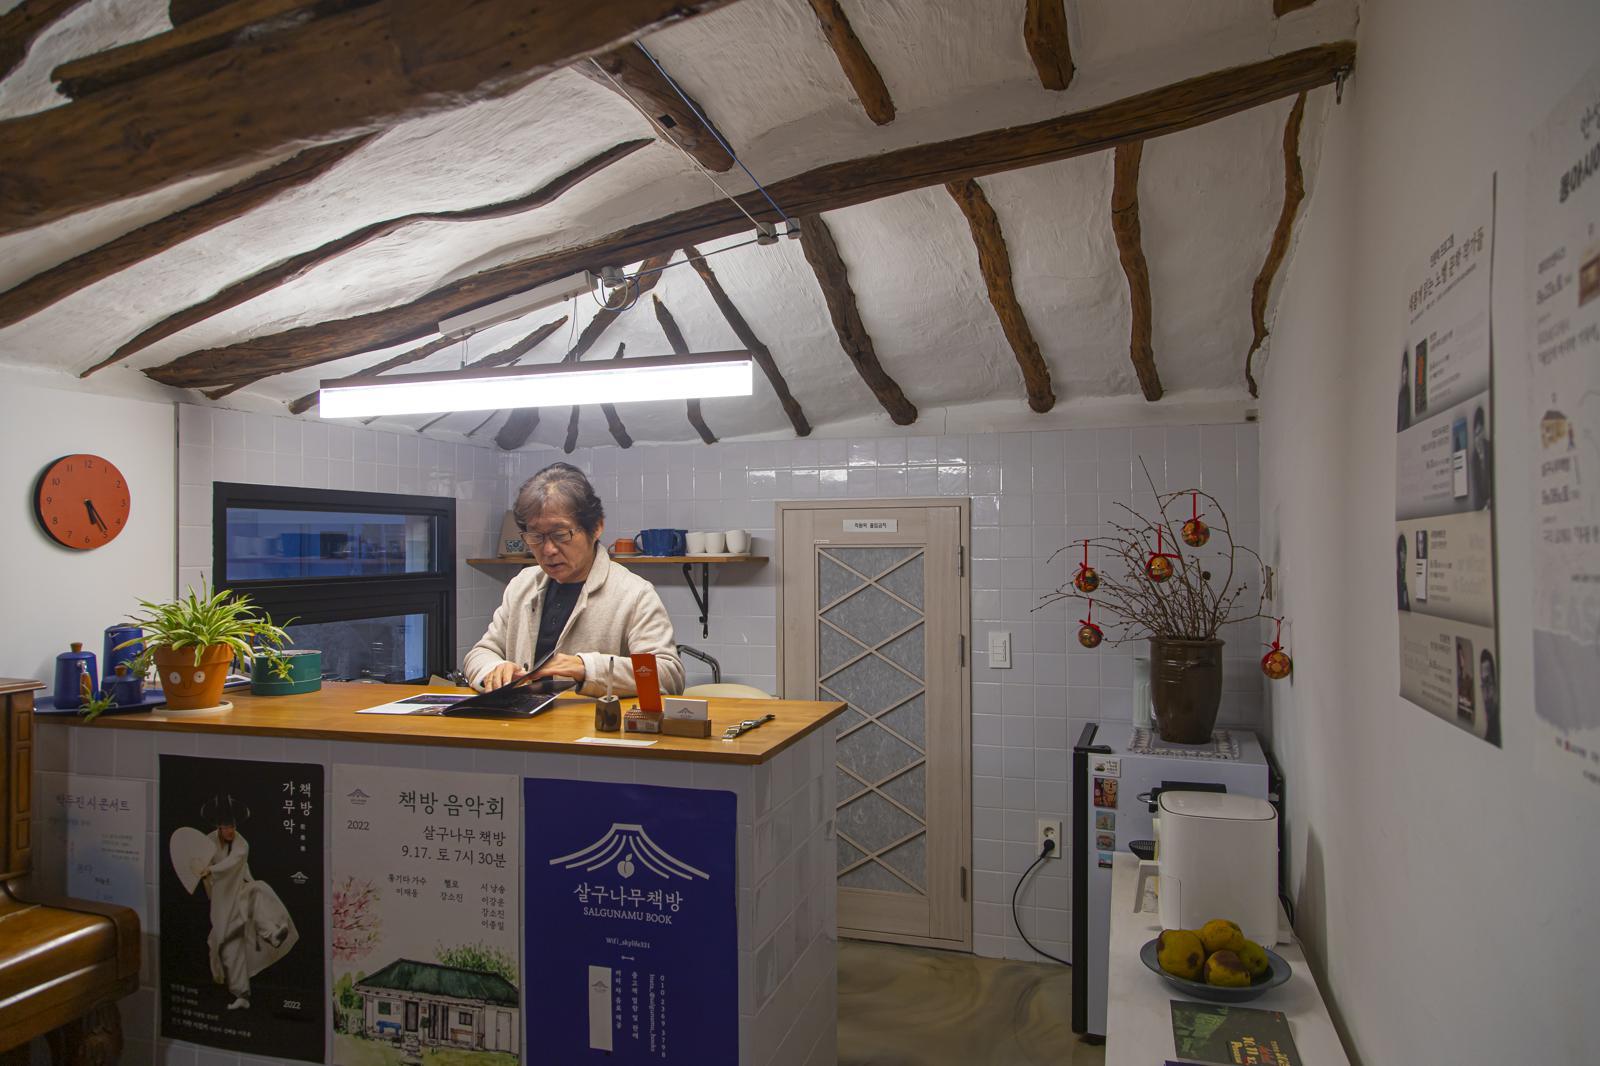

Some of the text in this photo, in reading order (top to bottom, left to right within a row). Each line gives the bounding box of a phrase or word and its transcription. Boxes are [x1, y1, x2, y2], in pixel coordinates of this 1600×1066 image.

[282, 780, 297, 835] 가무악
[299, 782, 313, 817] 책방
[399, 790, 504, 821] 책방 음악회
[347, 819, 370, 831] 2022
[423, 824, 507, 848] 살구나무 책방
[401, 845, 507, 869] 9.17. 토 7시 30분
[573, 881, 684, 912] 살구나무책방
[583, 906, 673, 925] SALGUNAMU BOOK
[283, 999, 301, 1010] 2022
